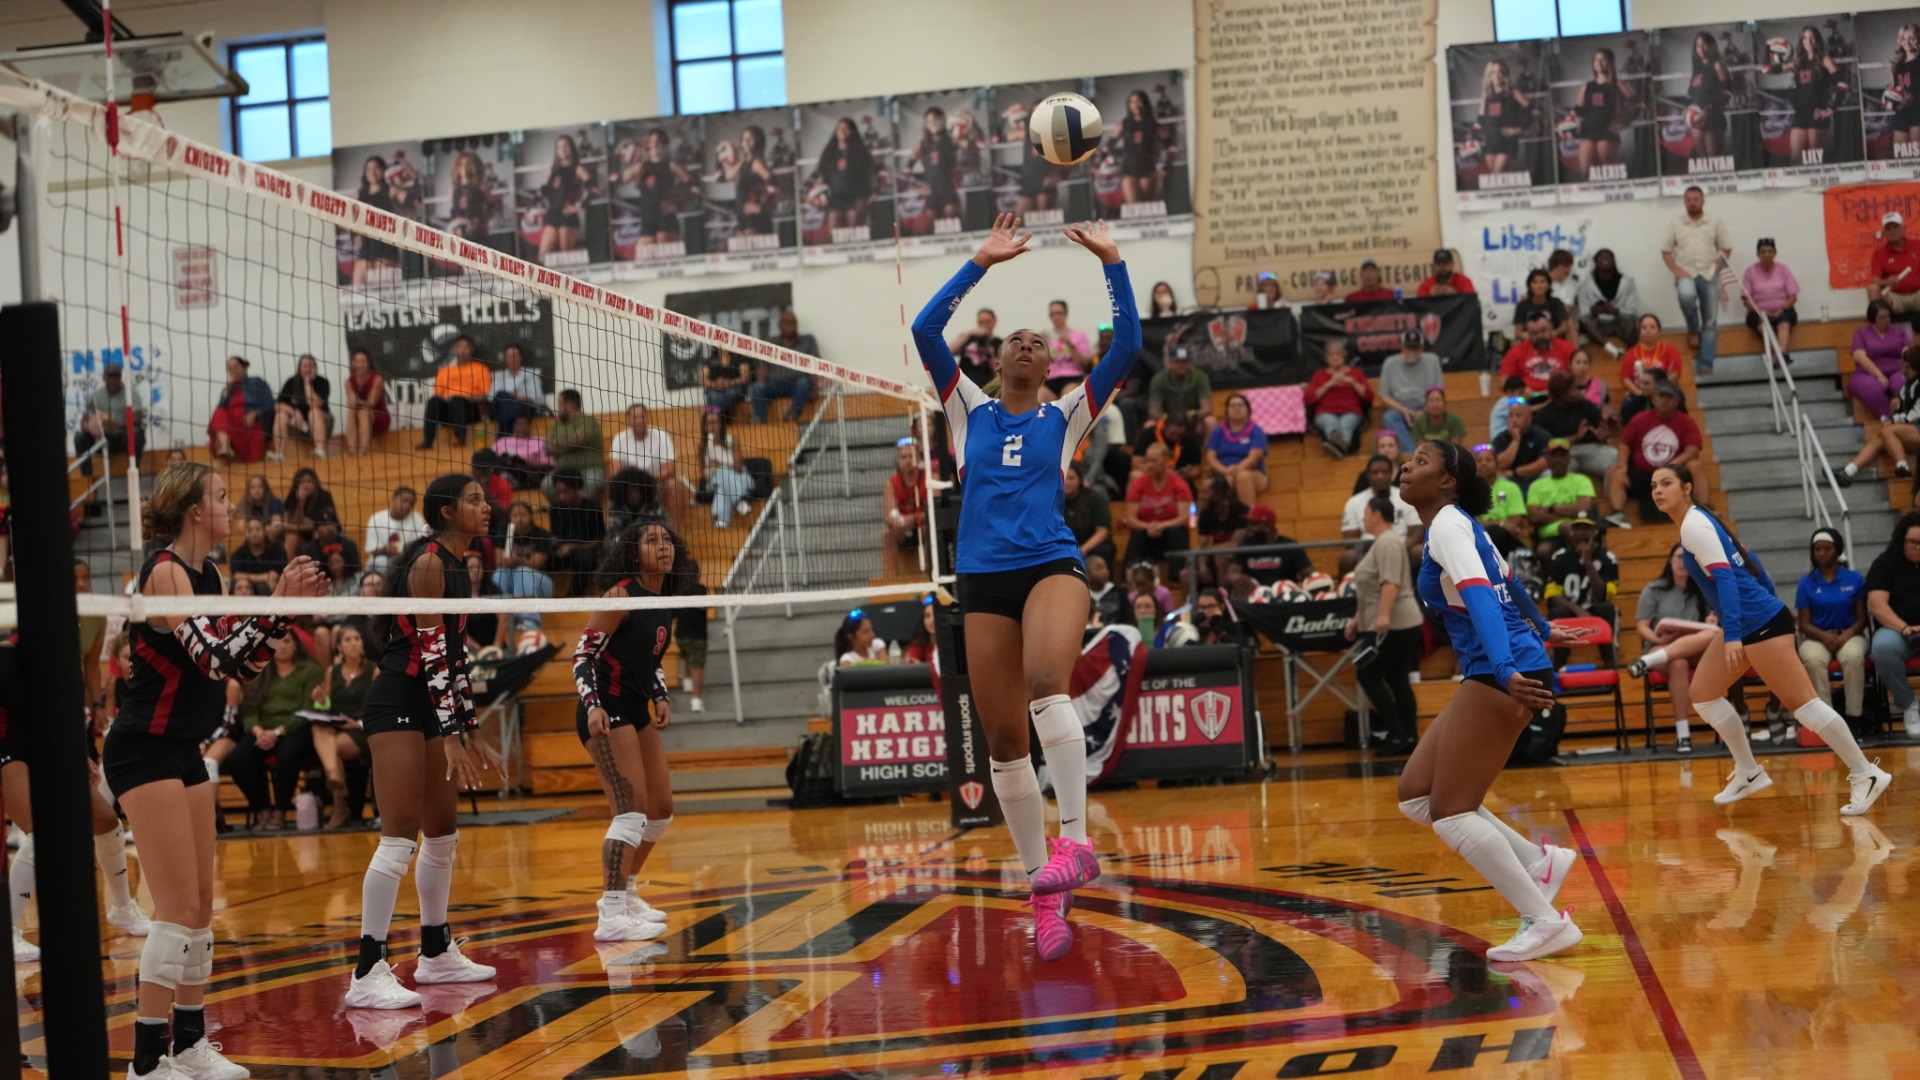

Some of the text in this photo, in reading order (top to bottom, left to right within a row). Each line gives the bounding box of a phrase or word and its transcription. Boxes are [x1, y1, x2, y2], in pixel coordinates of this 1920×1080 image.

[1801, 147, 1824, 164] LILY
[184, 145, 230, 178] KNIGHTS
[310, 190, 347, 218] KNIGHTS
[1483, 223, 1586, 256] Liberty
[346, 298, 541, 332] EASTERN HILLS
[1002, 434, 1023, 467] 2
[653, 626, 667, 655] 9
[1152, 680, 1168, 690] OF
[1172, 678, 1196, 689] THE
[884, 693, 939, 706] WELCOM
[856, 710, 946, 736] HARK
[851, 736, 947, 761] HEIGH
[861, 763, 950, 781] HIGH SCH
